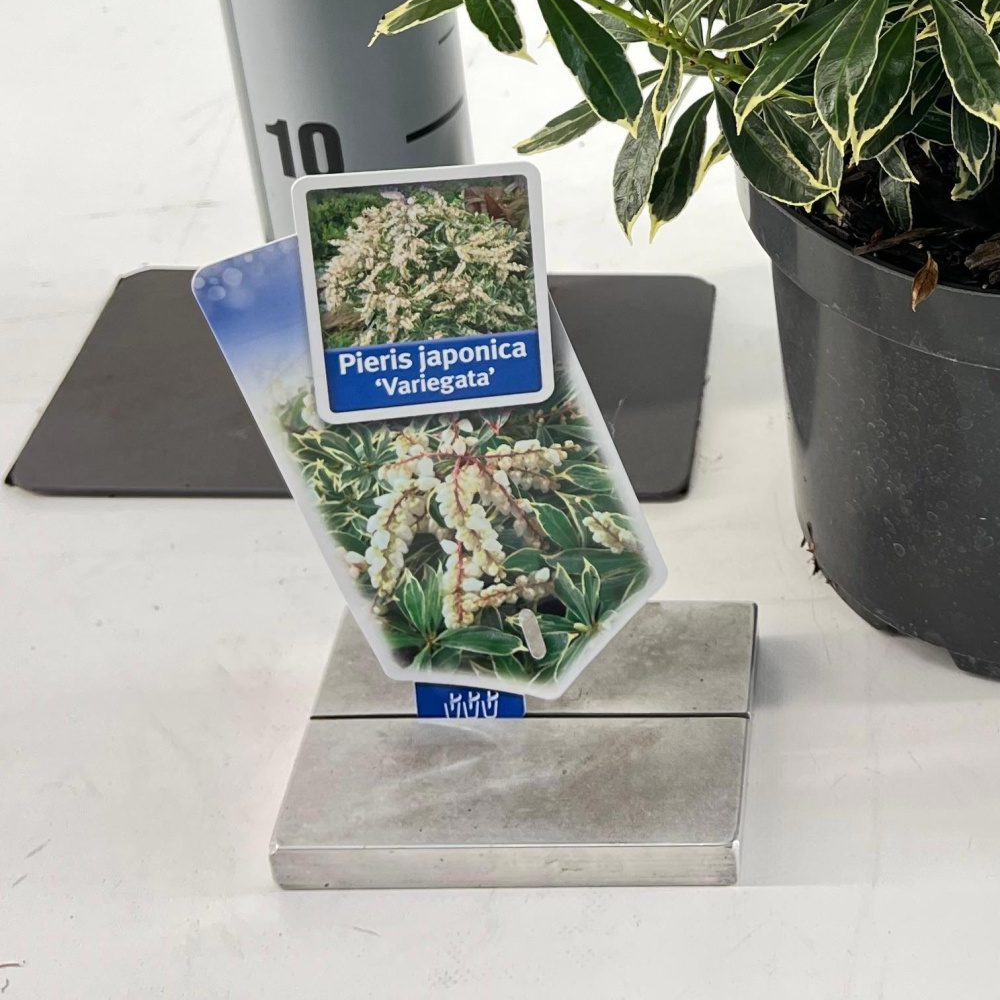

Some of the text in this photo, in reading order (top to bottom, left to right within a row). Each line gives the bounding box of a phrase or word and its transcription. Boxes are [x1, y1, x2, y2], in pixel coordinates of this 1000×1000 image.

[266, 119, 345, 178] 10
[339, 338, 527, 375] Pieris japonica
